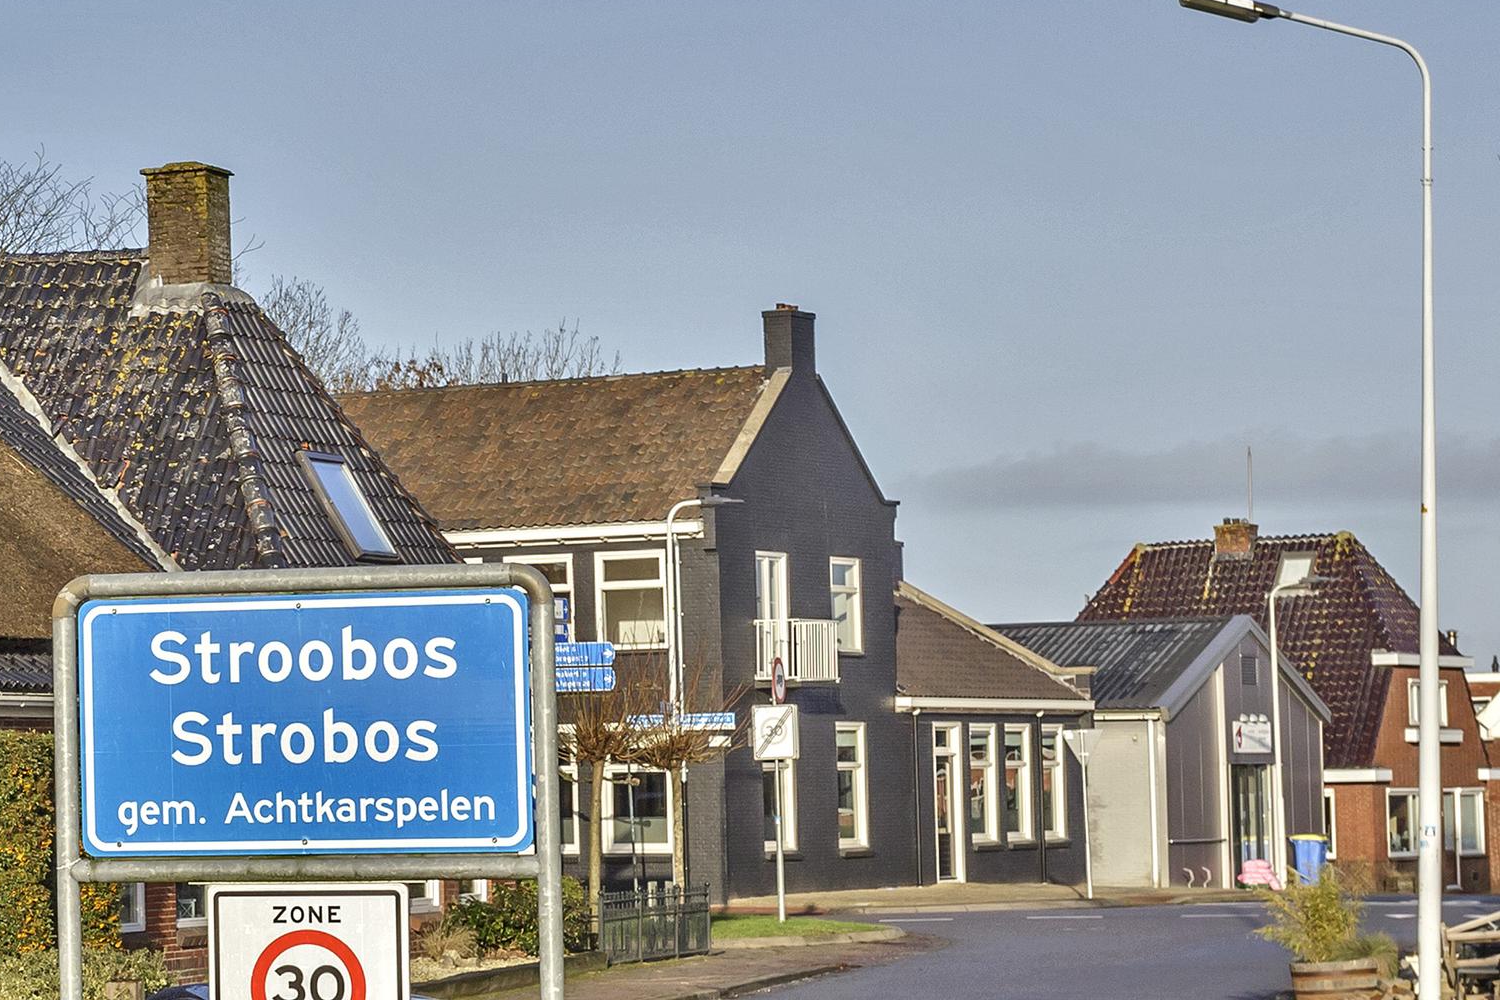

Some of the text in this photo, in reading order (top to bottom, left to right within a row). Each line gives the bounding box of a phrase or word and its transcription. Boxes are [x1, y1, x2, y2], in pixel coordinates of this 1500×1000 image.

[149, 624, 458, 685] Stroobos
[171, 708, 439, 766] Strobos
[766, 725, 783, 737] 30
[117, 788, 498, 836] gem. Achtkarspelen
[272, 905, 342, 924] ZONE
[272, 964, 346, 1000] 30
